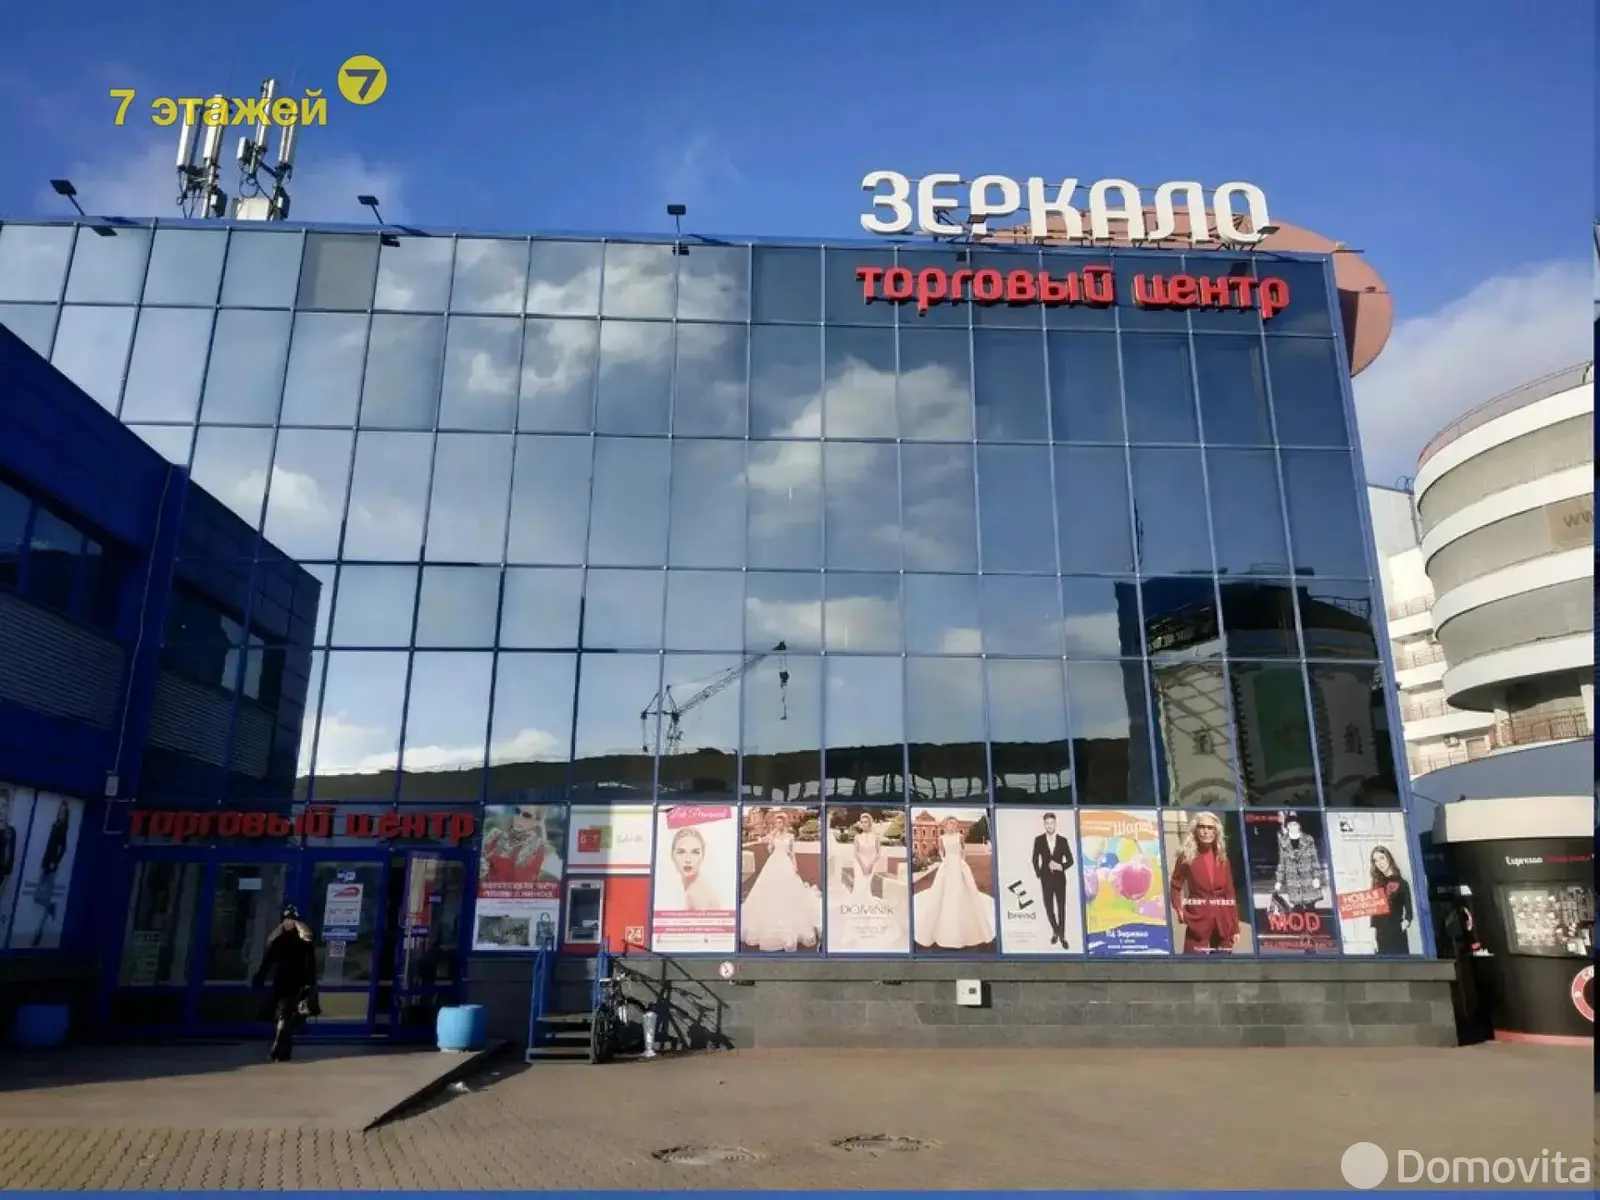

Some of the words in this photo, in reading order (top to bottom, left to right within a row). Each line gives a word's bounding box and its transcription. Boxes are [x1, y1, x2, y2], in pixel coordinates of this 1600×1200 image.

[860, 170, 1268, 243] ЗЕРКАЛО
[856, 265, 1116, 315] торговый
[1133, 273, 1290, 320] центр
[129, 804, 336, 843] торговый
[345, 810, 475, 845] центр
